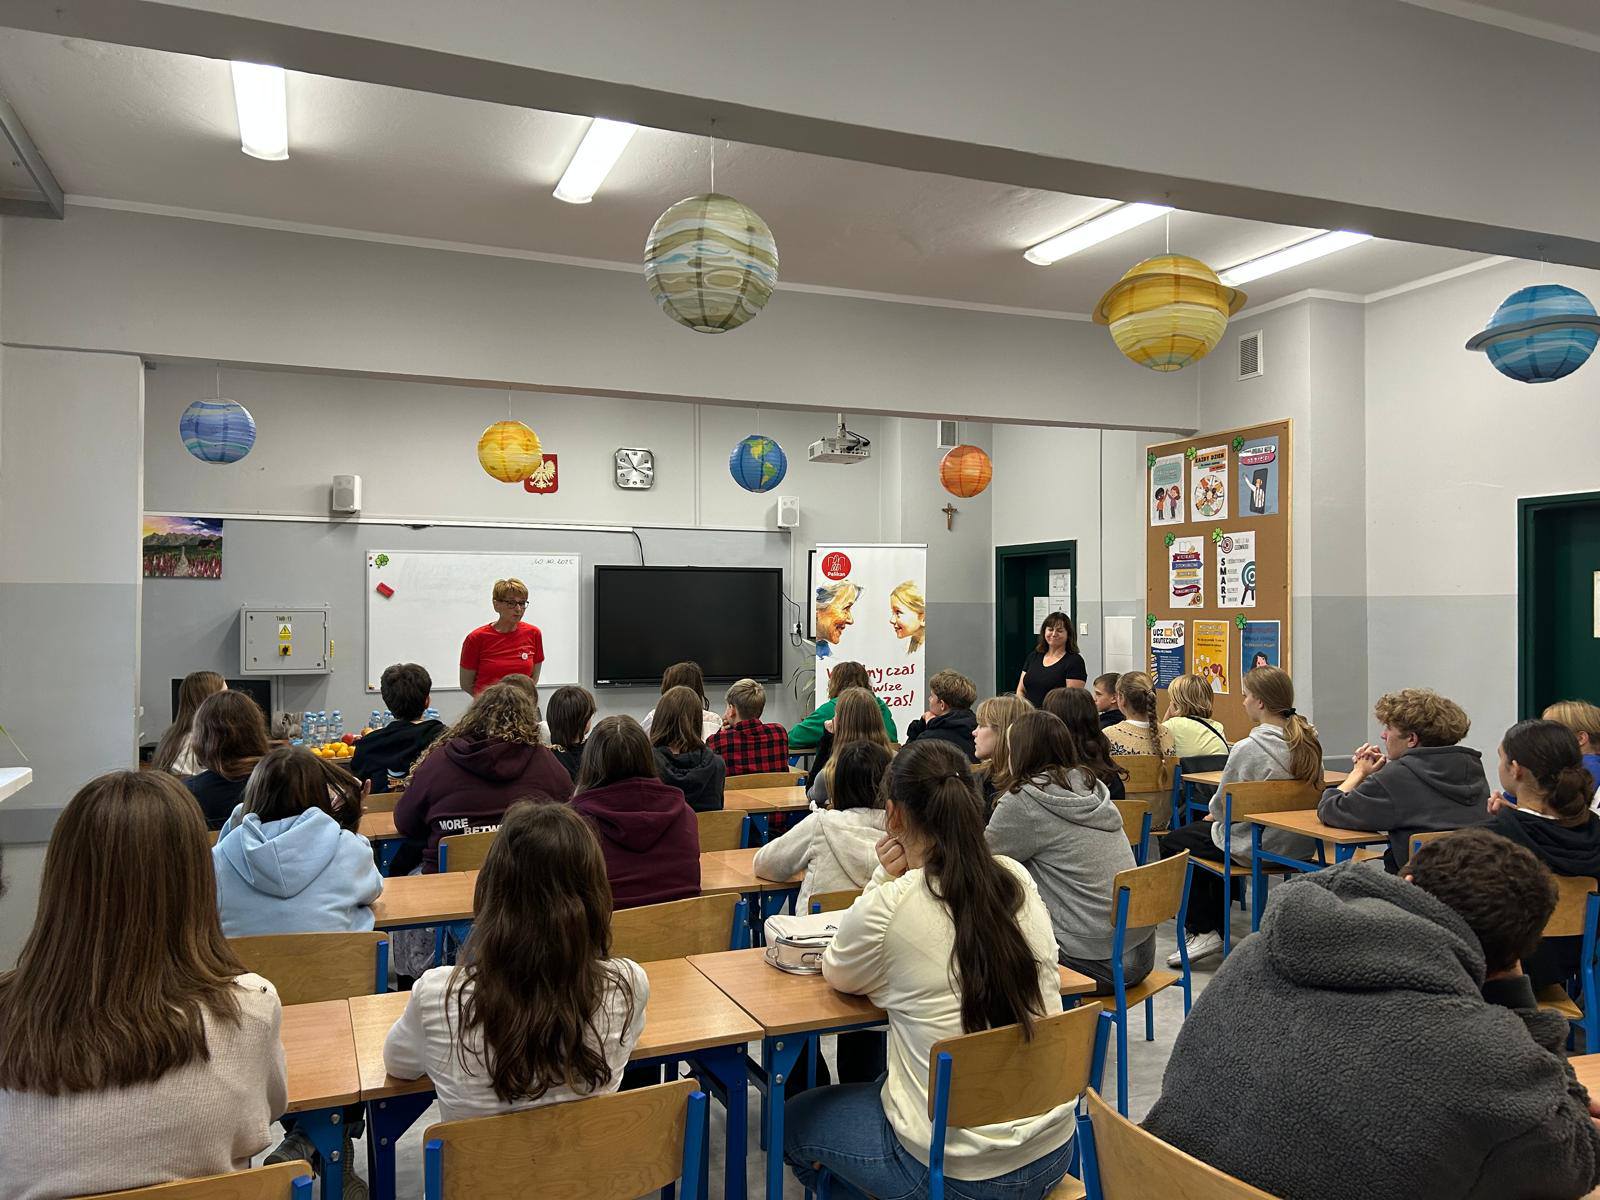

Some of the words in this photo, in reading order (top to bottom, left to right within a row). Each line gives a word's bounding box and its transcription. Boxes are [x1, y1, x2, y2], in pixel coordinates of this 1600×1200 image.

[1153, 628, 1164, 637] UCZ
[886, 663, 915, 677] czas
[872, 682, 903, 693] wsze
[883, 690, 914, 707] zas!
[439, 818, 469, 831] MORE
[464, 824, 503, 835] BETW
